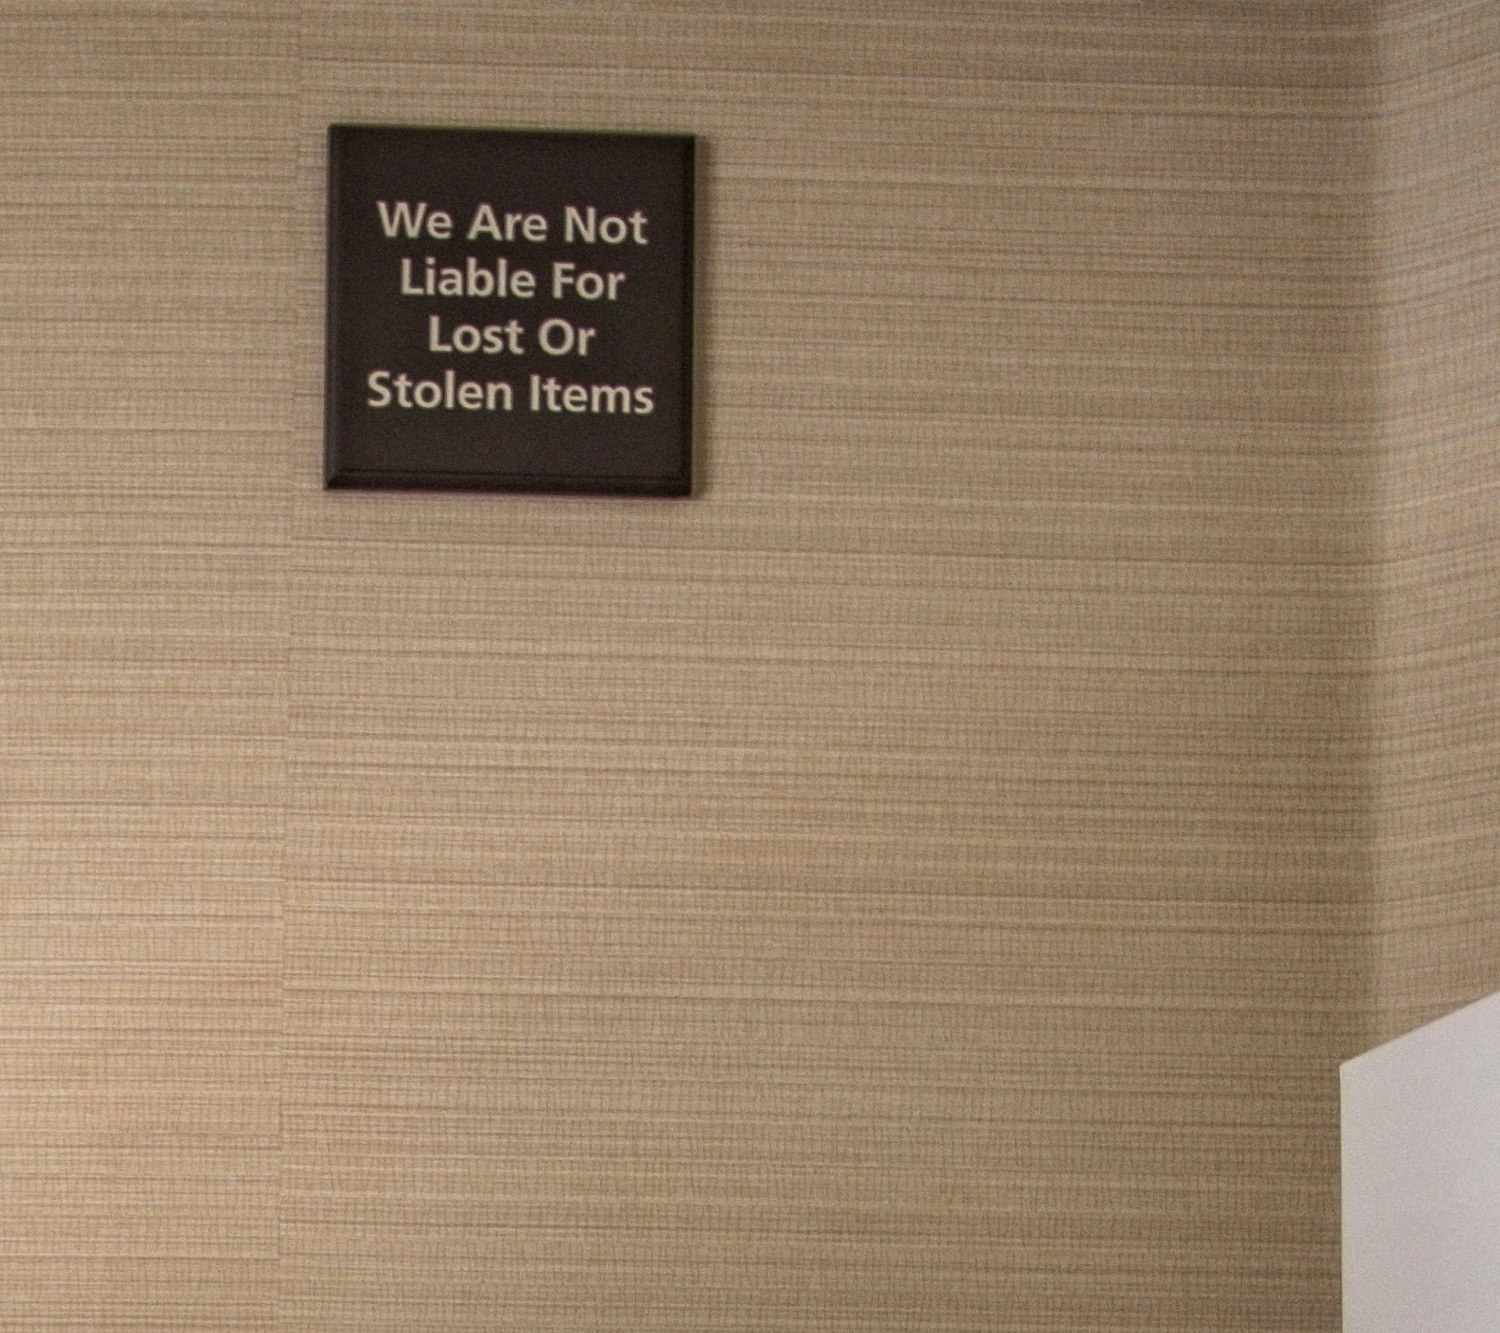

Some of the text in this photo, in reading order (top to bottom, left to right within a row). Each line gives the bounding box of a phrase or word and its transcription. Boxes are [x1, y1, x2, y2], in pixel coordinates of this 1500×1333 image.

[376, 201, 649, 245] We Are Not
[401, 257, 625, 300] Liable For
[428, 316, 596, 356] Lost Or
[367, 370, 655, 415] Stolen Items
